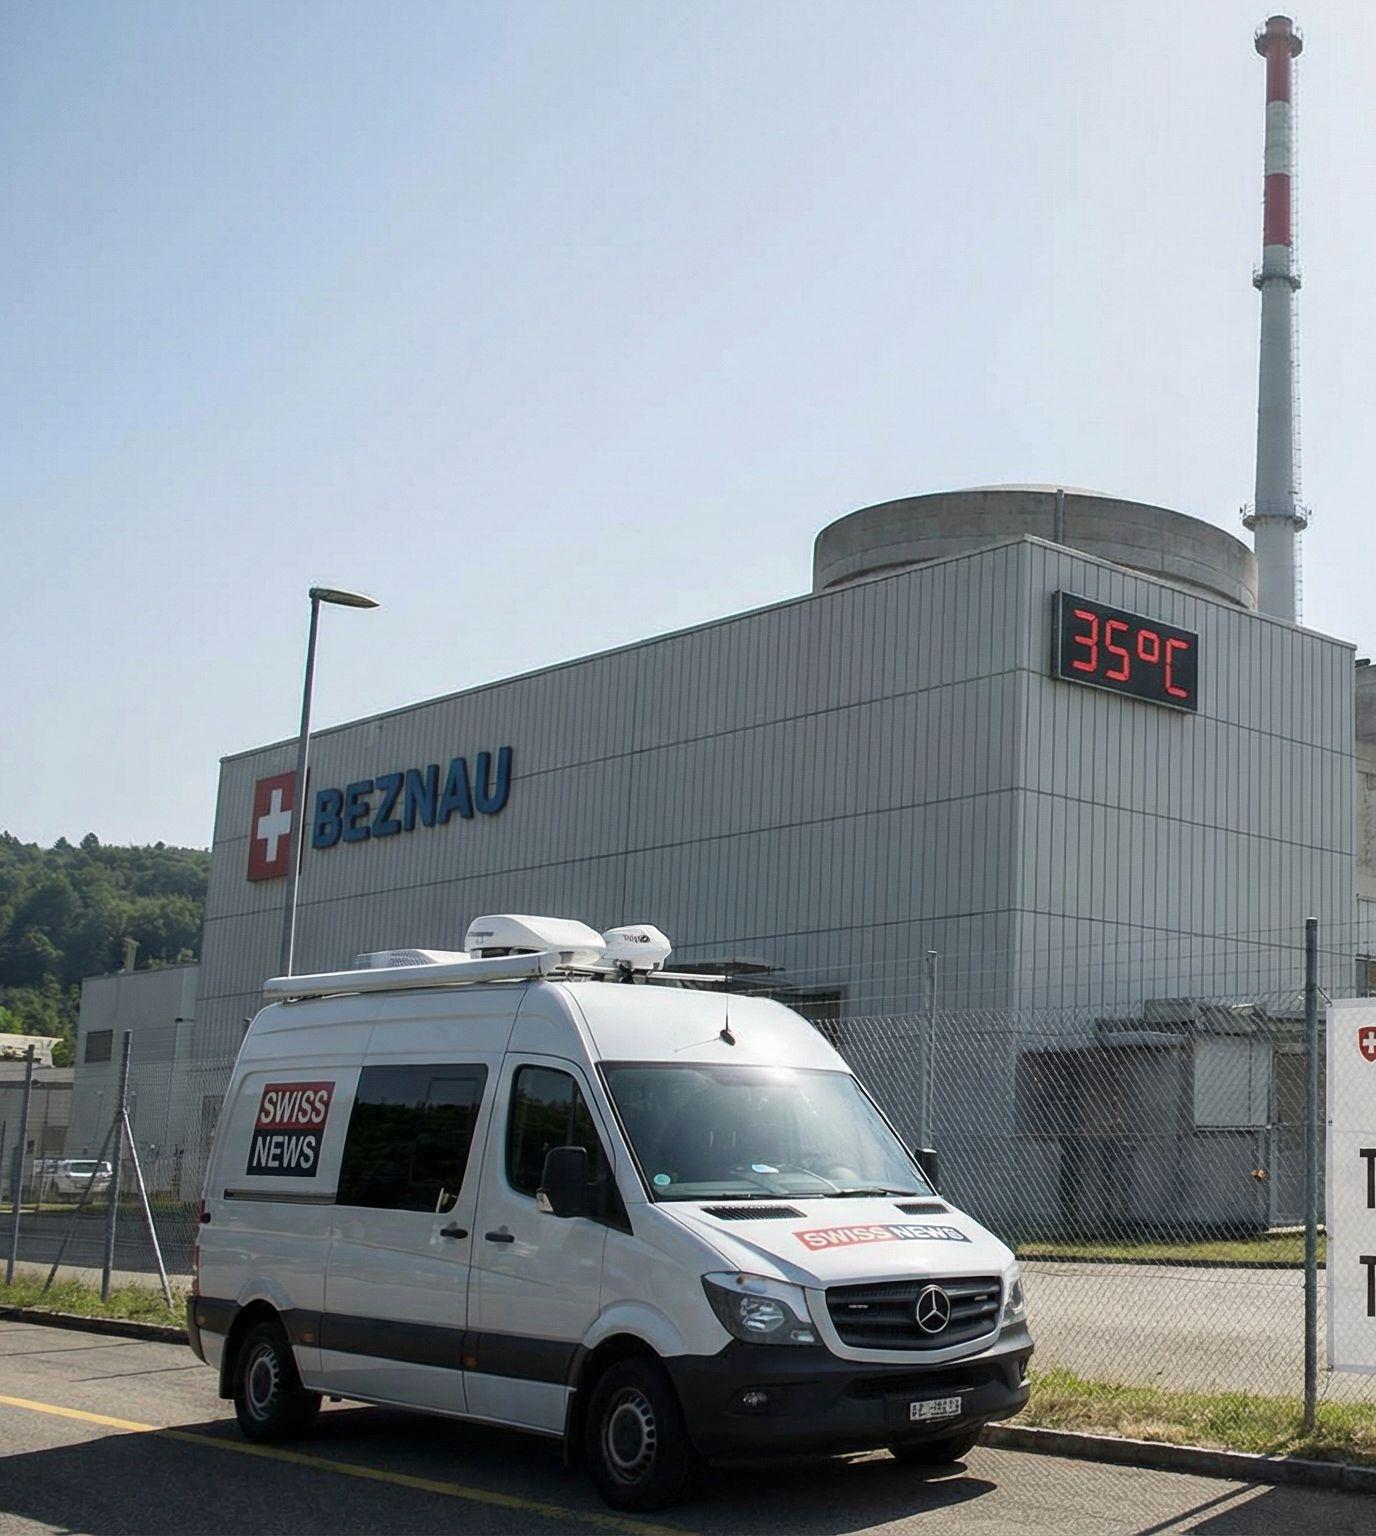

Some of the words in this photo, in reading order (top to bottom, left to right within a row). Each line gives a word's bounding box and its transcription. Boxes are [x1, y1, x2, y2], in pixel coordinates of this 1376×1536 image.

[312, 746, 513, 849] BEZNAU
[260, 1089, 328, 1124] SWISS
[252, 1135, 316, 1169] NEWS
[803, 1226, 890, 1247] SWISS
